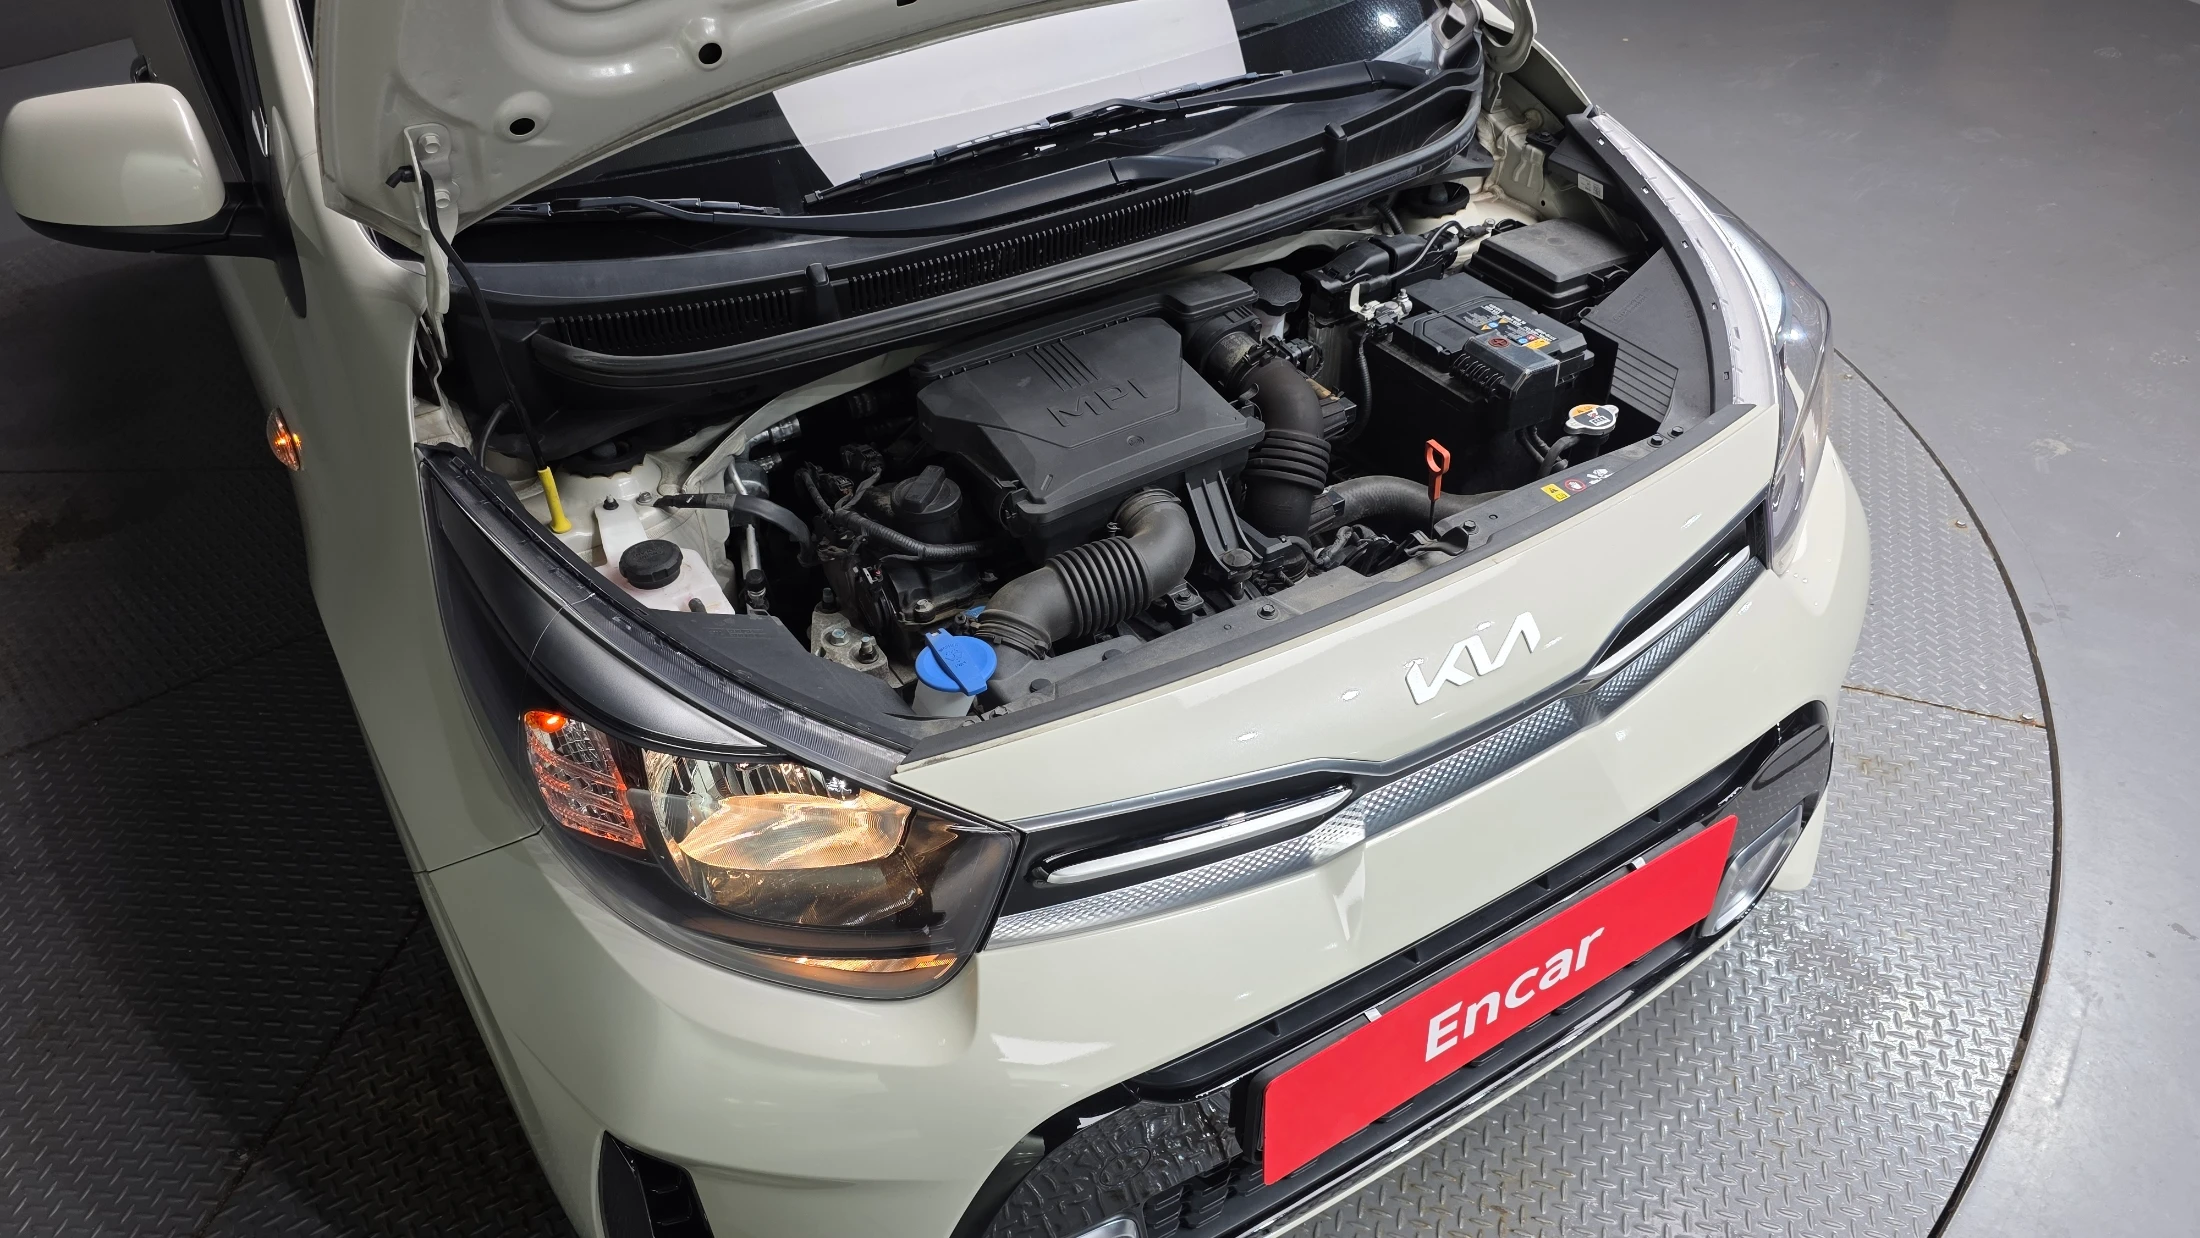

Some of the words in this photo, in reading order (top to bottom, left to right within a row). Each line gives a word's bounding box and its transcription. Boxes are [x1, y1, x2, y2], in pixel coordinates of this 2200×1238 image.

[1046, 379, 1149, 428] MPI
[1405, 611, 1541, 705] KIA
[1425, 927, 1605, 1062] Encar
